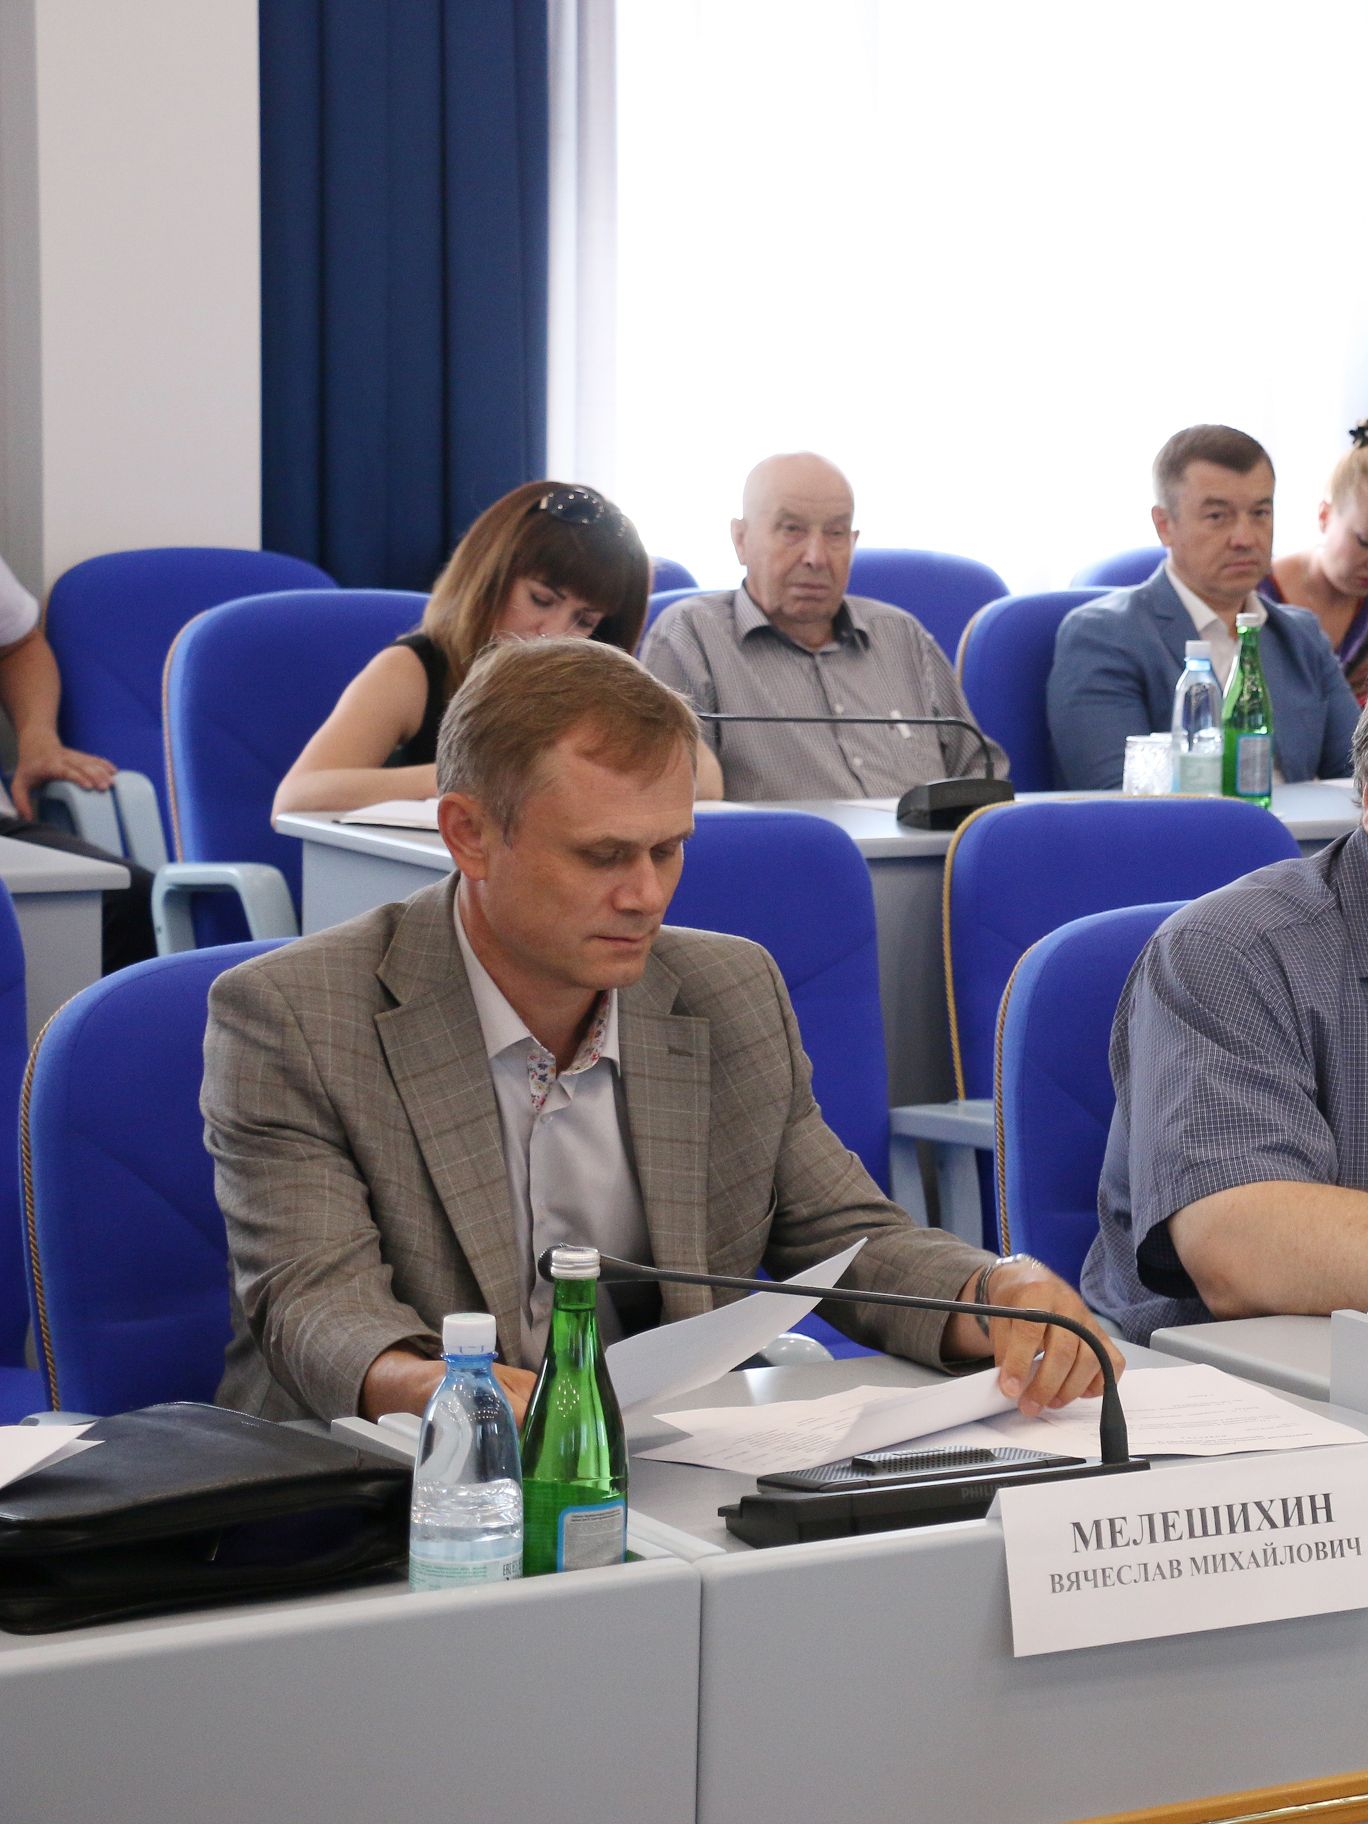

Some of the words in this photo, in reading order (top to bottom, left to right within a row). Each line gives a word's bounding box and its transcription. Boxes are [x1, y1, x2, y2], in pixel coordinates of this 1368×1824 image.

[1070, 1492, 1336, 1554] МЕЛЕШИХИН
[1049, 1559, 1184, 1594] ВЯЧЕСЛАВ
[1188, 1536, 1363, 1577] МИХАЙЛОВИЧ
